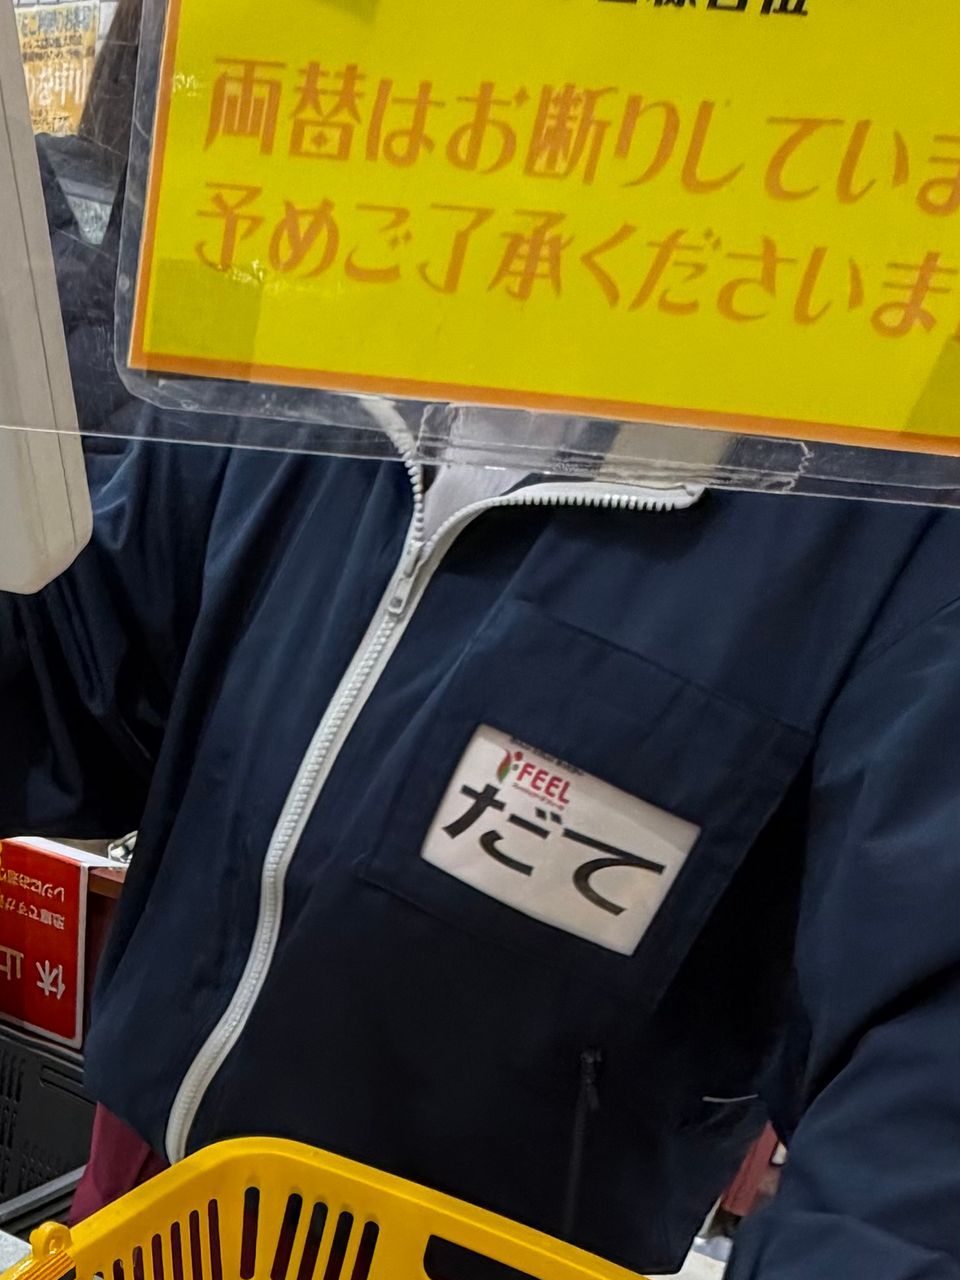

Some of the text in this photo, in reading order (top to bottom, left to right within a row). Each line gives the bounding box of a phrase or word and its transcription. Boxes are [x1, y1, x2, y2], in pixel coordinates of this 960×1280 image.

[193, 180, 959, 338] 予めご了承くださいま
[442, 782, 665, 916] だて
[518, 761, 570, 805] FEEL
